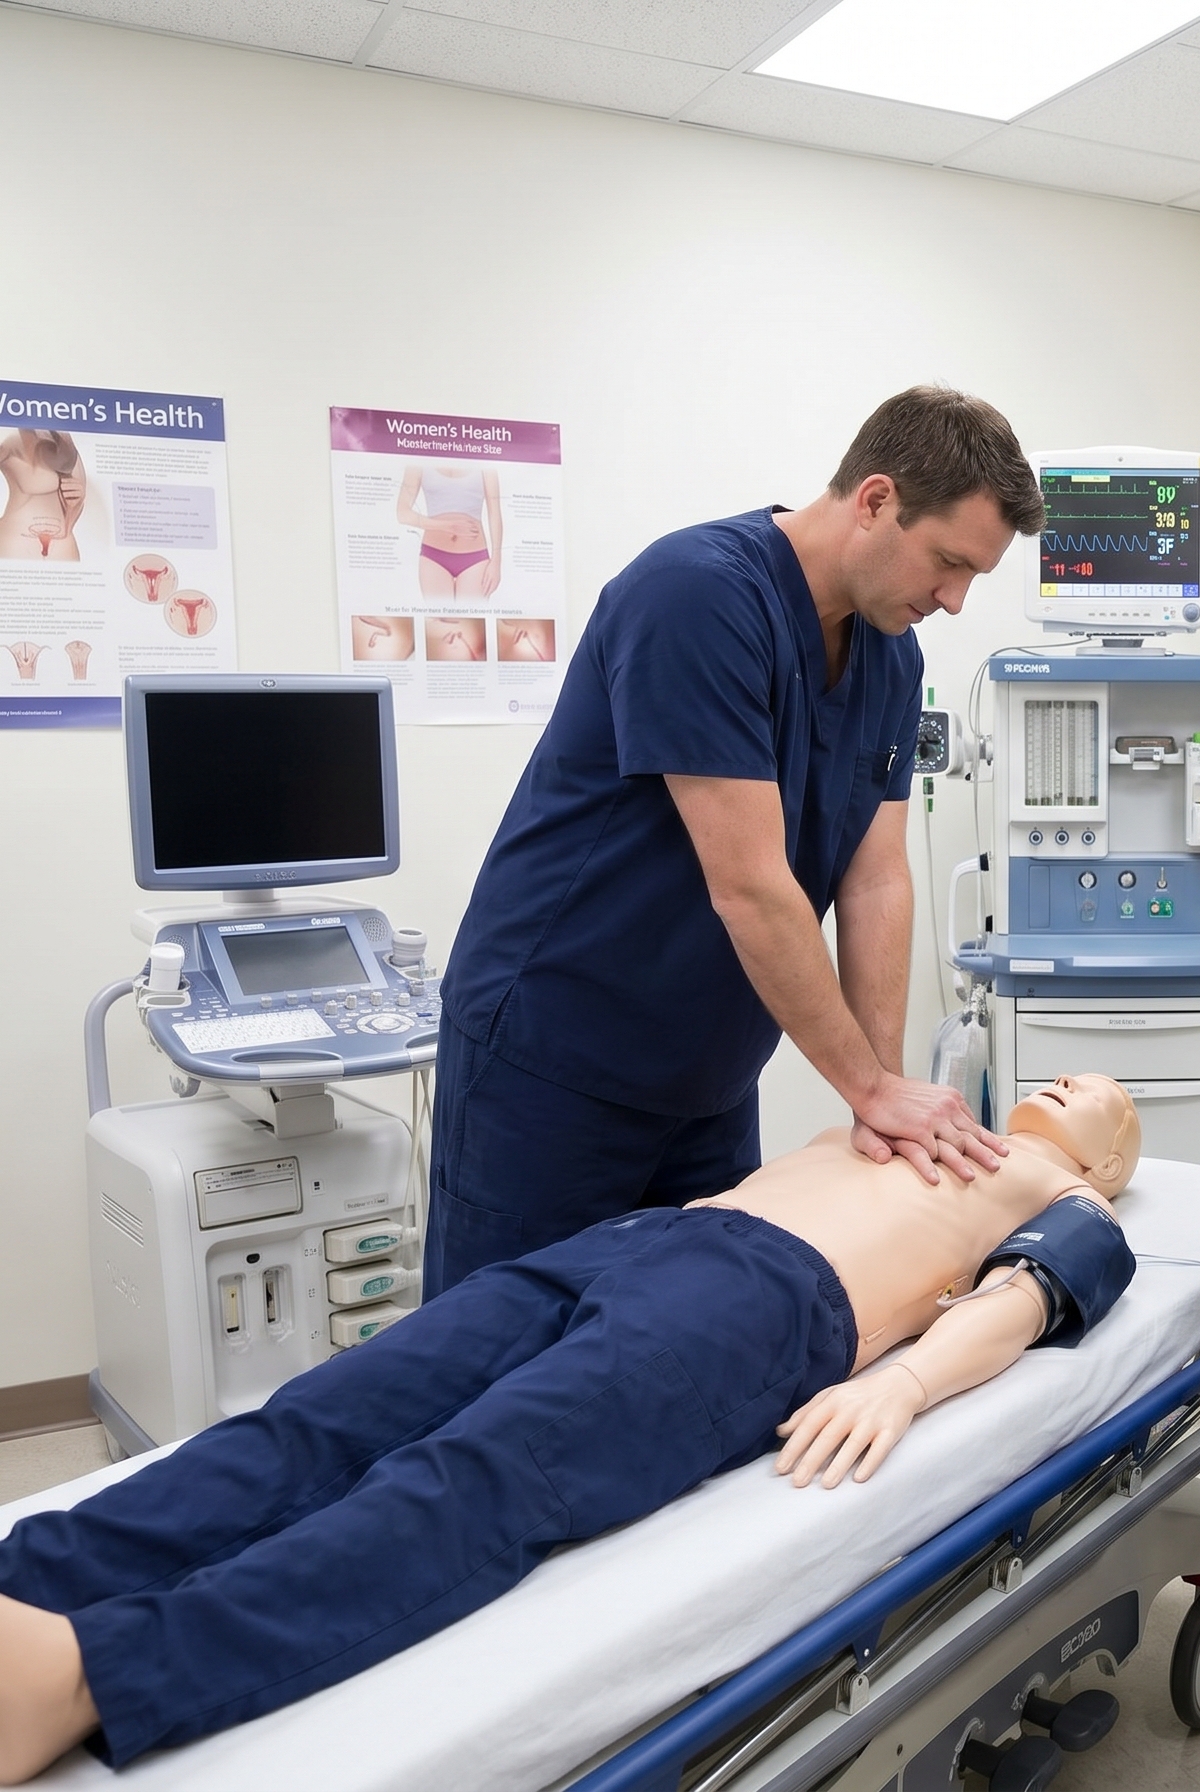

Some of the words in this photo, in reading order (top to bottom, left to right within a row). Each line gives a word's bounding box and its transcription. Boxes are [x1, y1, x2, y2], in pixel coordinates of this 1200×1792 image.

[0, 393, 107, 422] omen's
[115, 401, 204, 429] Health
[386, 418, 458, 438] Women's
[462, 424, 512, 442] Health
